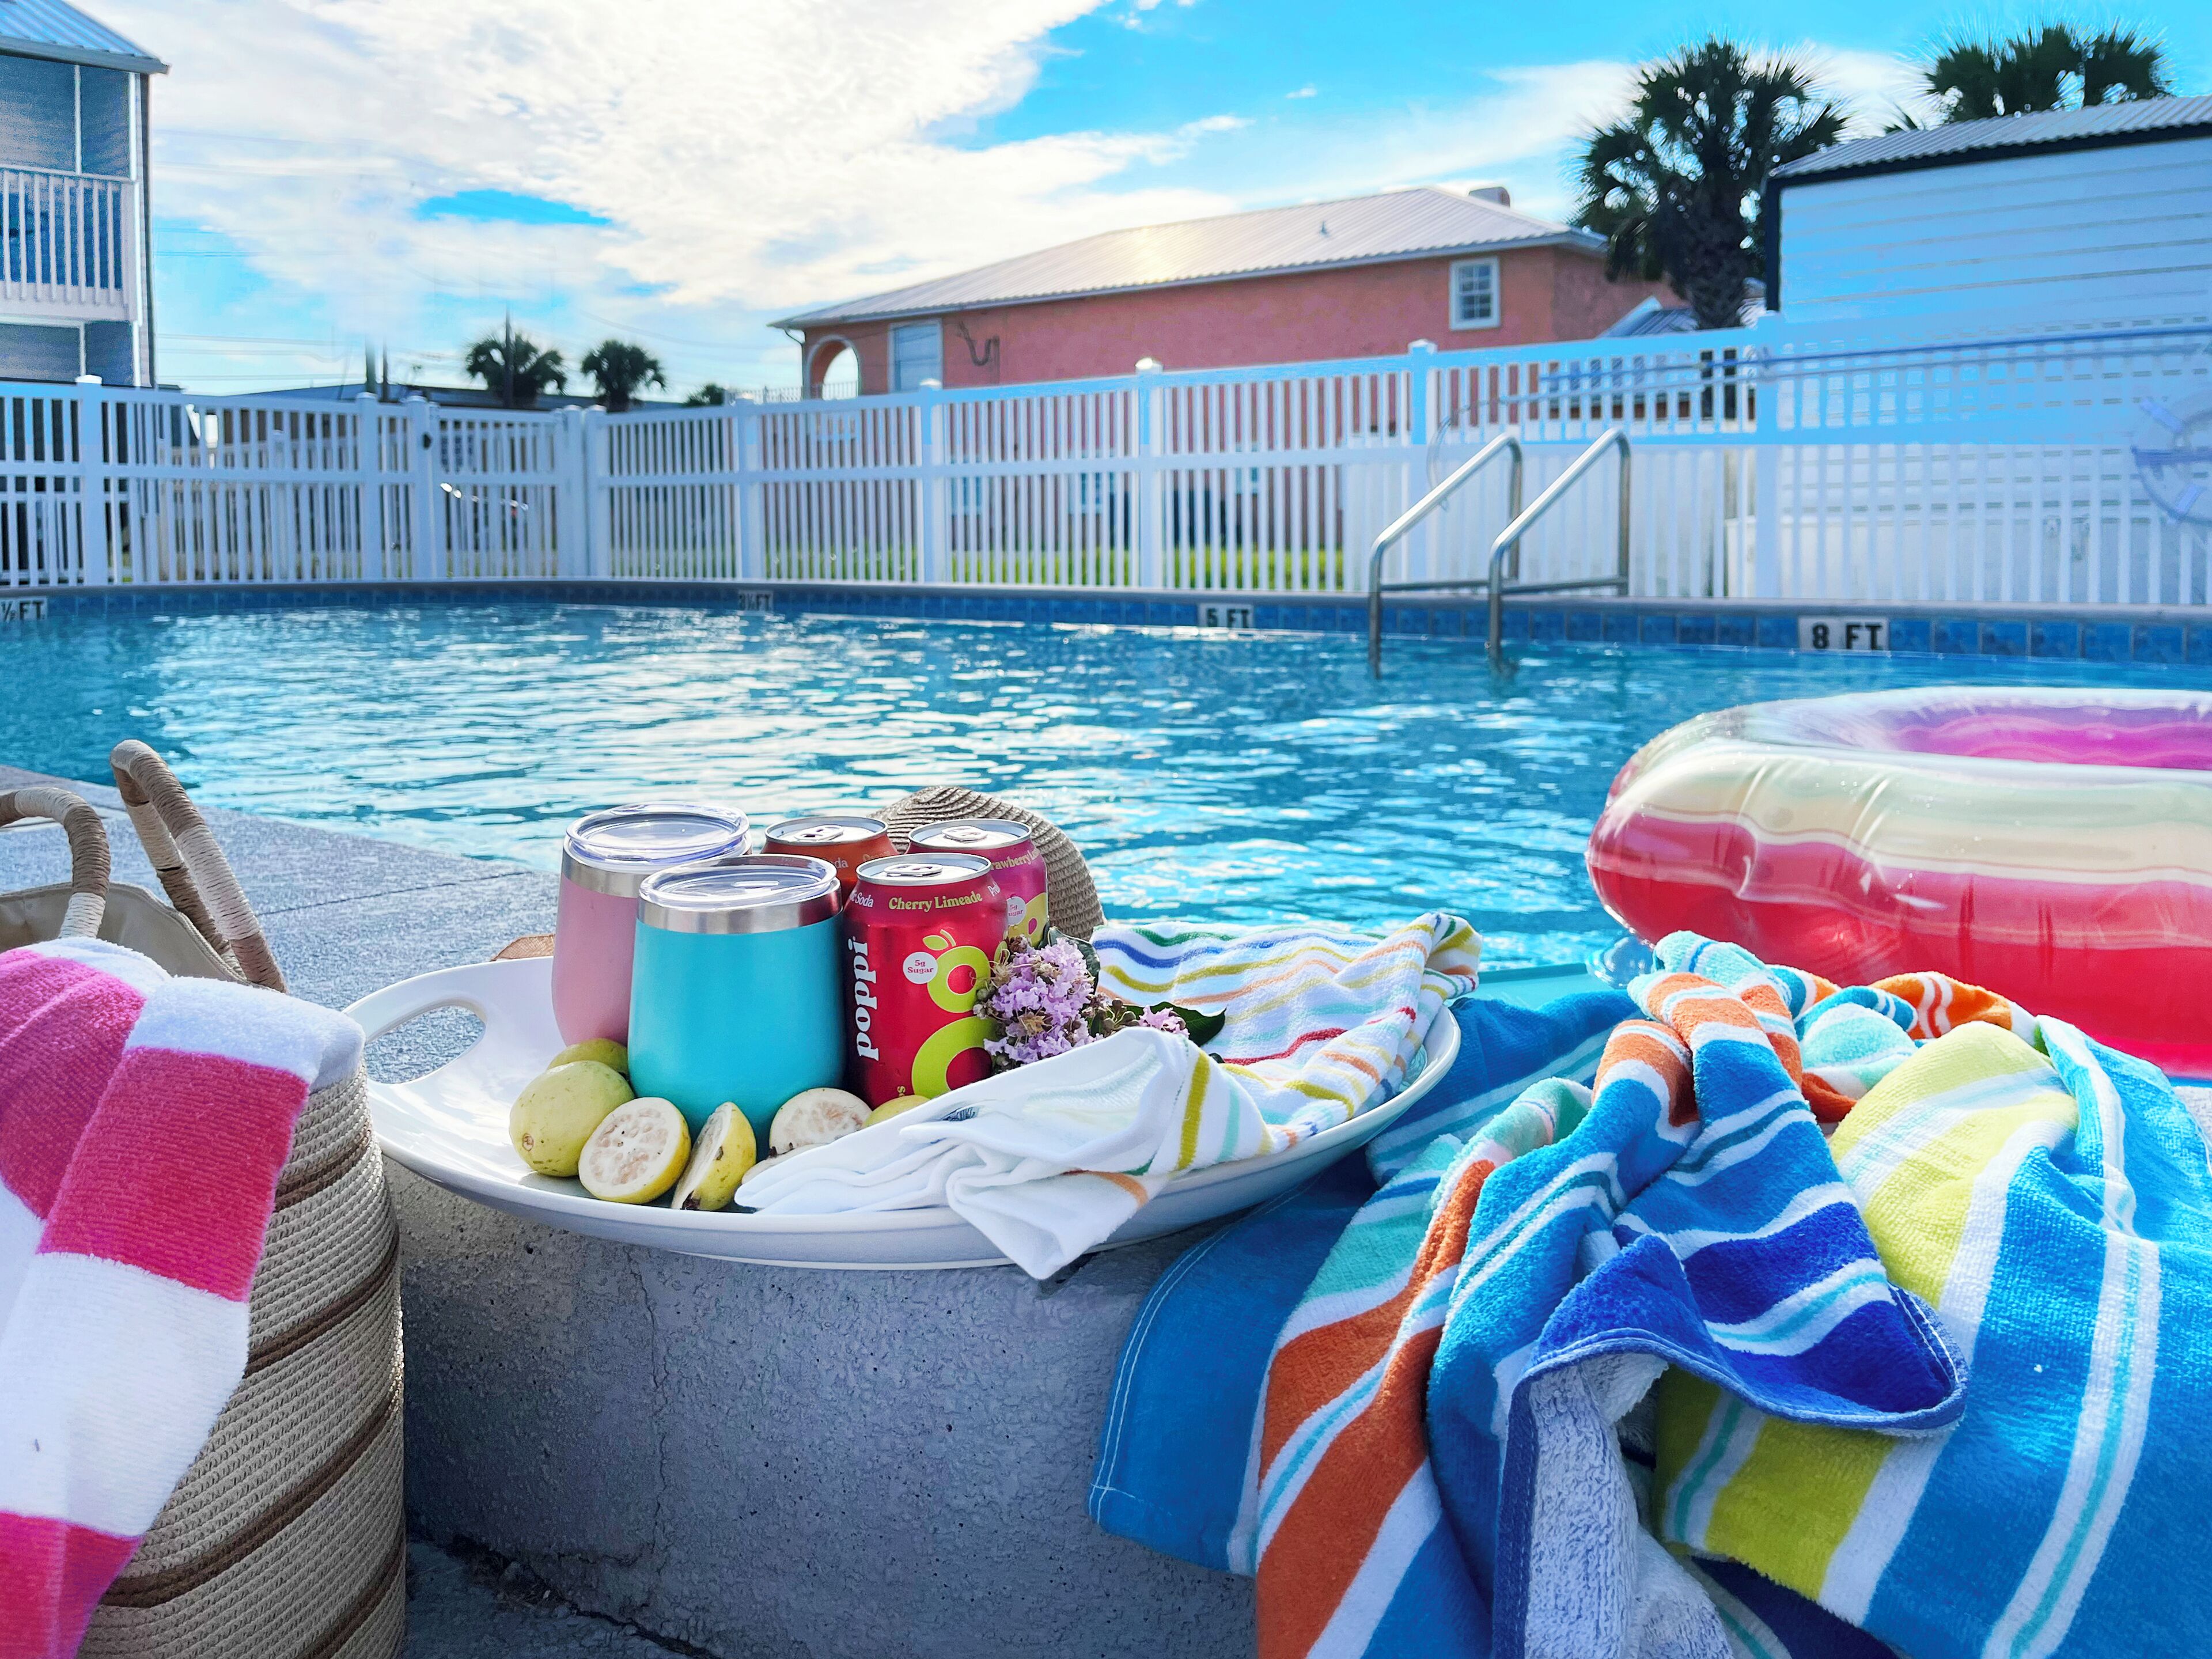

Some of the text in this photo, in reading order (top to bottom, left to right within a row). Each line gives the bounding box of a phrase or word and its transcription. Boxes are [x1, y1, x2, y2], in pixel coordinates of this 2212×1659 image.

[20, 600, 44, 620] FT
[1207, 608, 1249, 628] 5 FT
[1812, 623, 1883, 650] 8 FT
[855, 892, 874, 907] Soda
[888, 891, 983, 912] Cherry Limeade
[848, 936, 879, 1061] poppi
